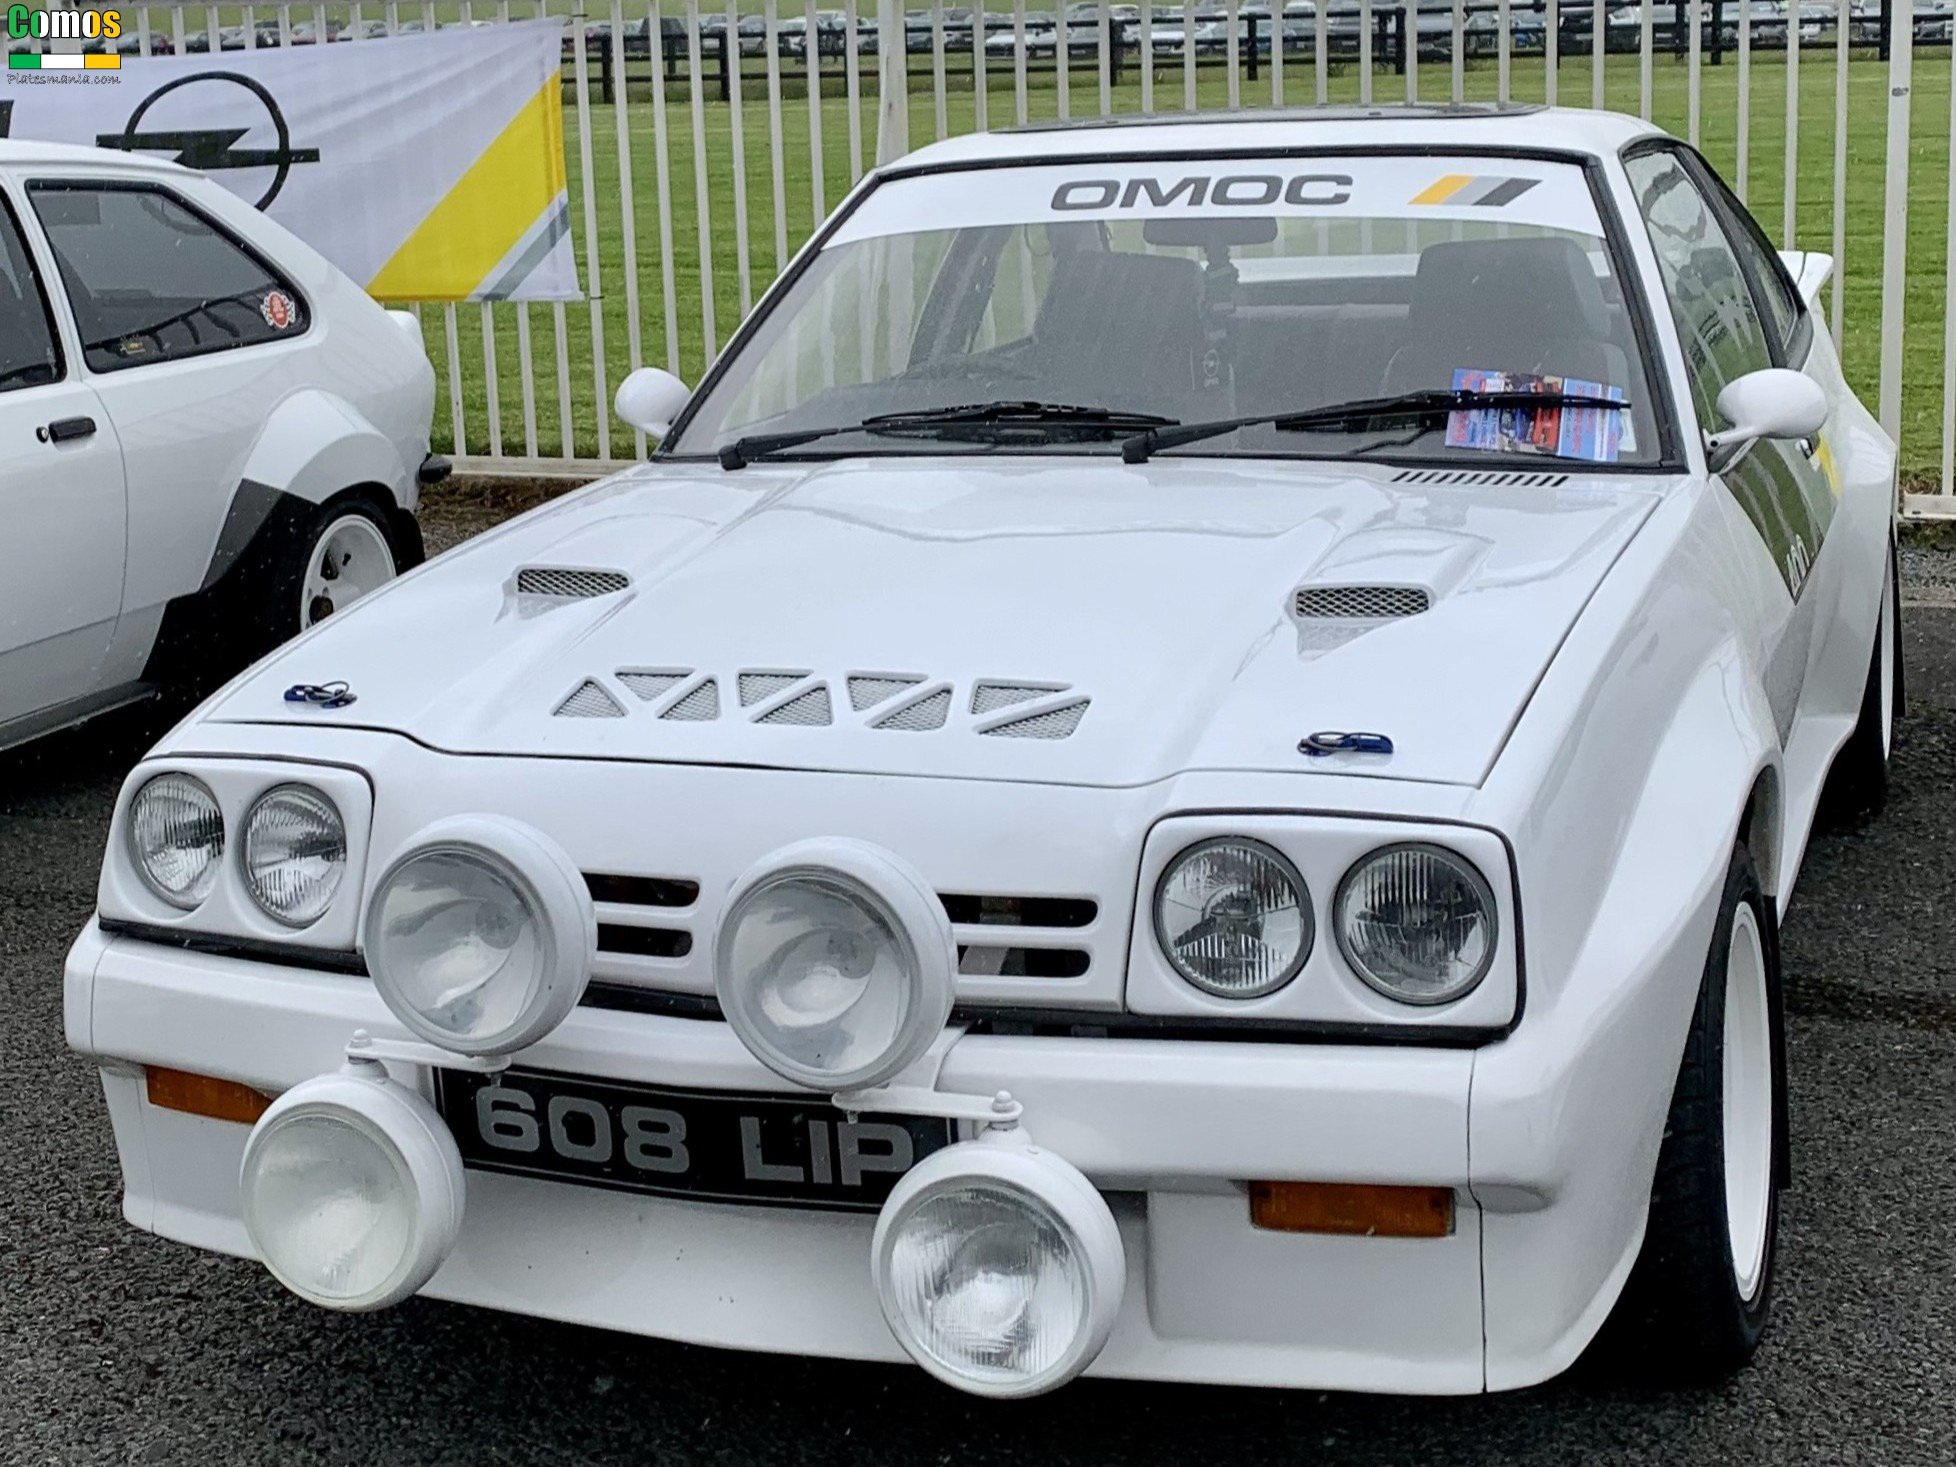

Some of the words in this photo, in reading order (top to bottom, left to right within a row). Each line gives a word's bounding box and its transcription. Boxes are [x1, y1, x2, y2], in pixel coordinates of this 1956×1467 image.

[1051, 174, 1354, 211] OMOC
[475, 1085, 690, 1174] 608
[739, 1115, 915, 1187] LIP
